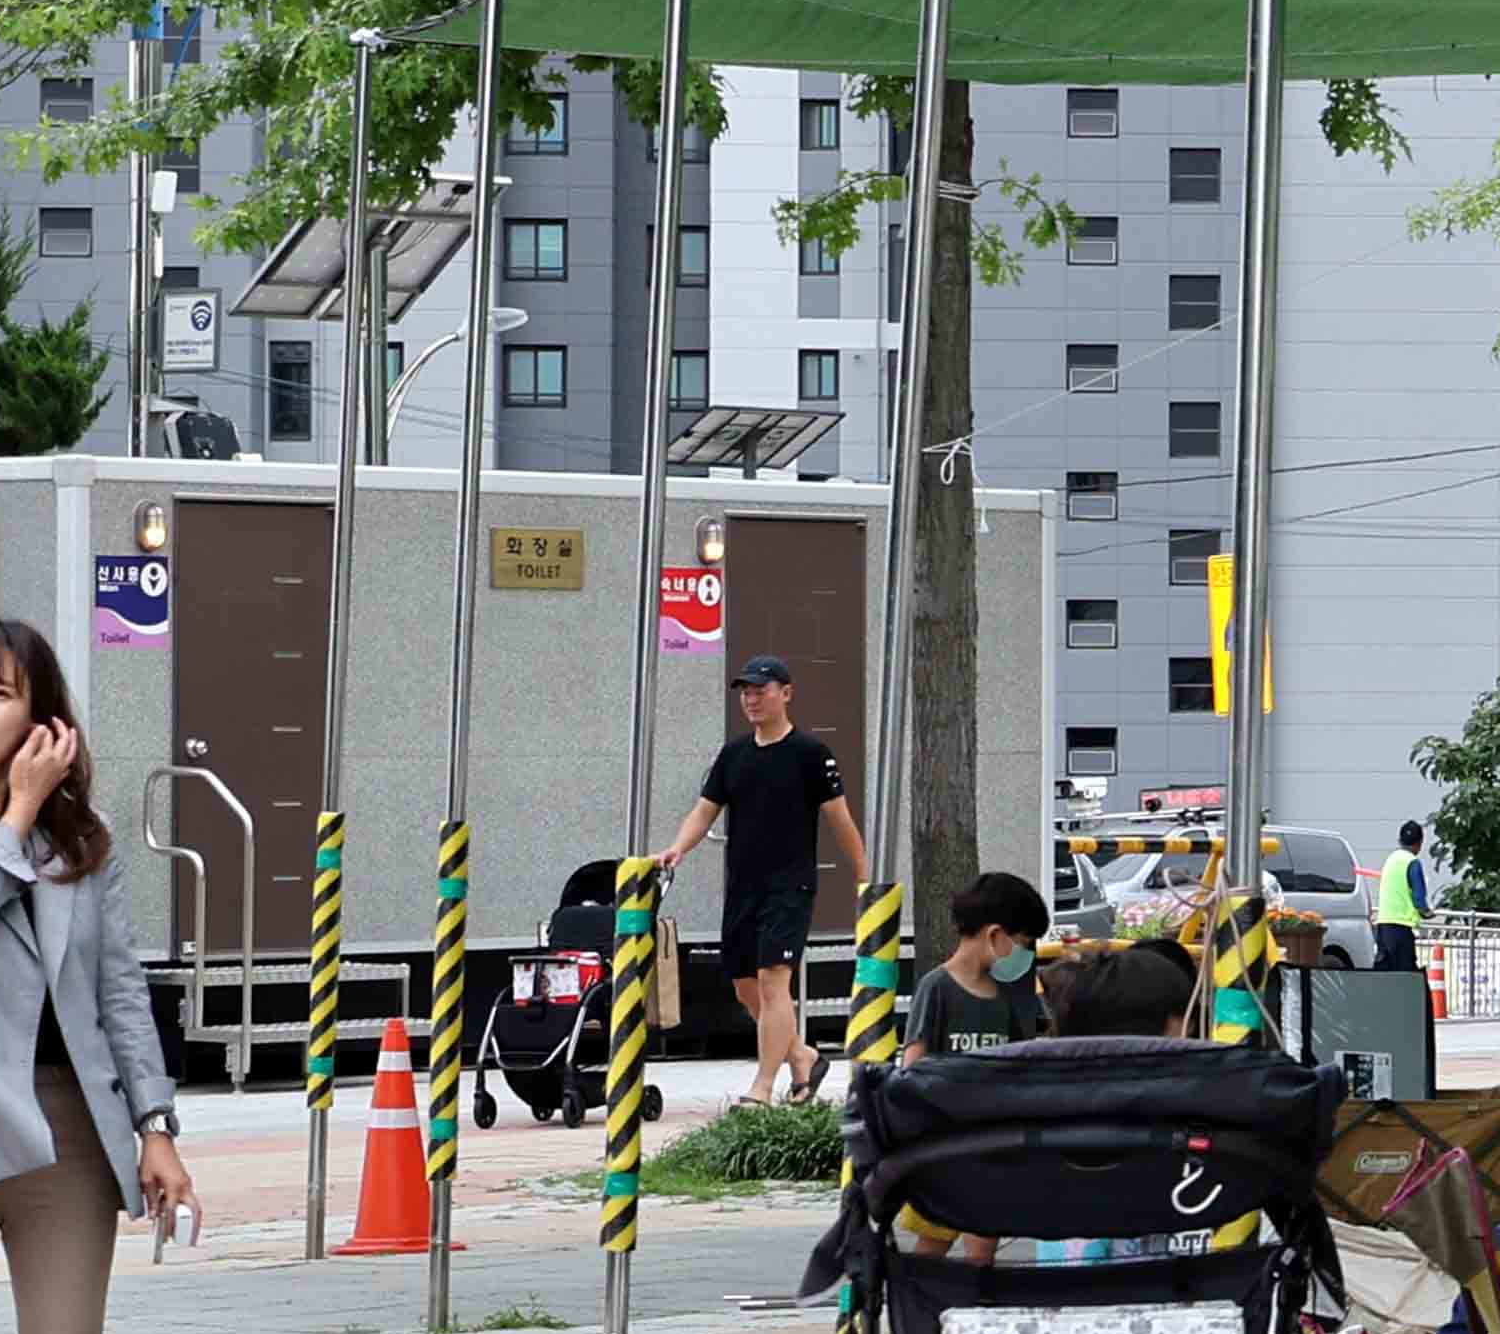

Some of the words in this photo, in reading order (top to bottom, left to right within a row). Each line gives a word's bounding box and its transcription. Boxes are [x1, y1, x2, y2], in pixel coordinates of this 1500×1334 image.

[505, 536, 573, 558] 화장실
[98, 566, 140, 582] 신사용
[516, 564, 562, 579] TOILET
[101, 632, 131, 644] Toilet
